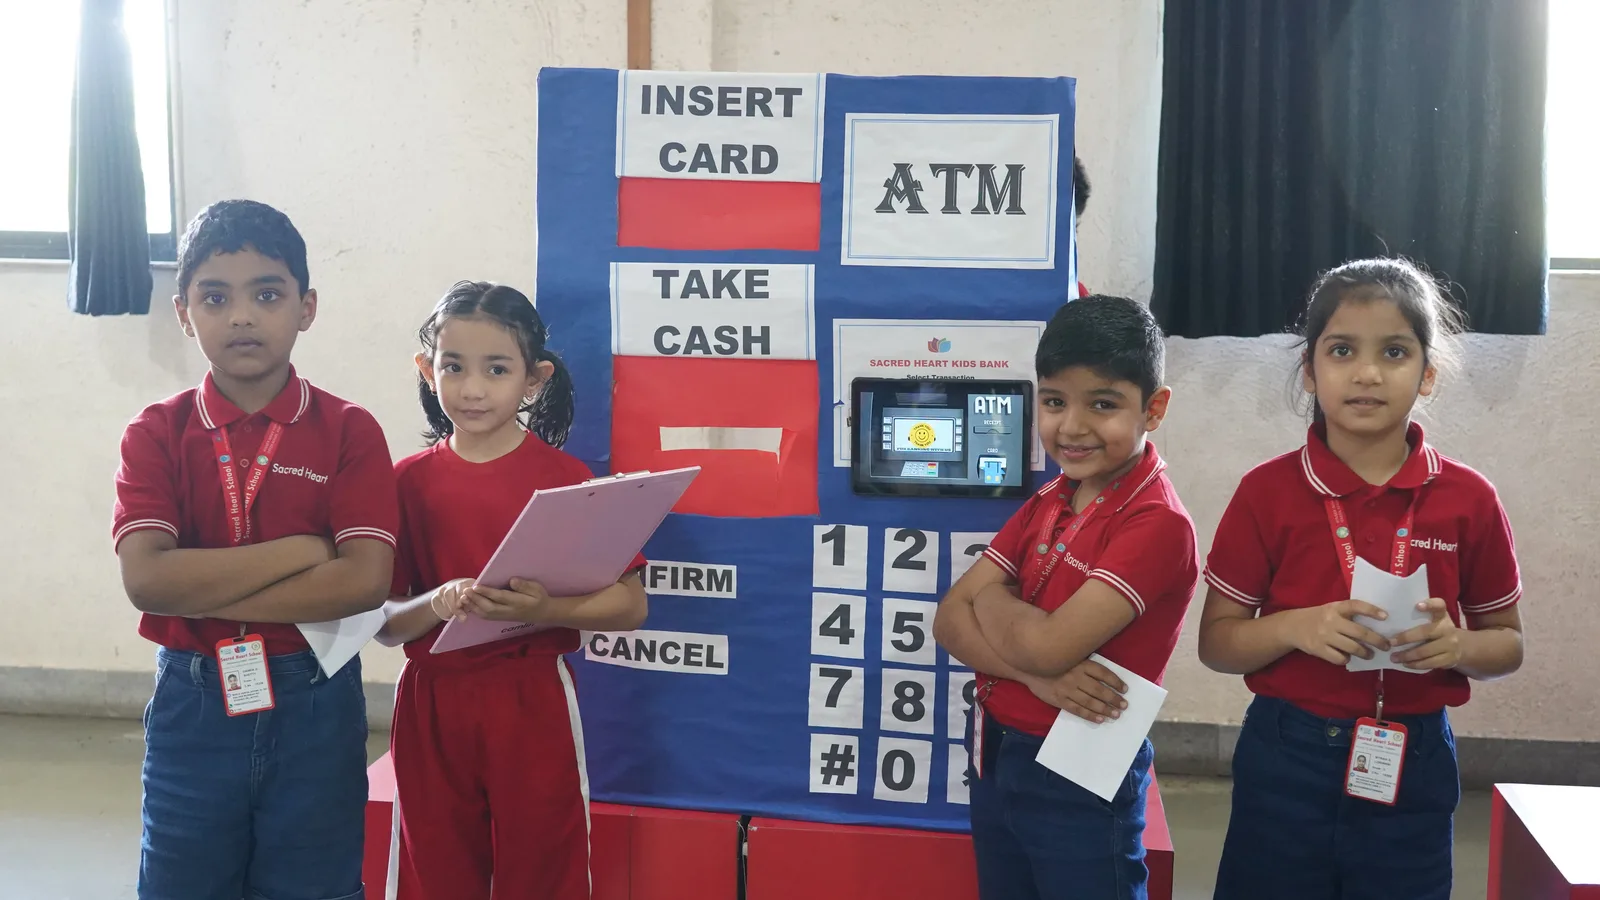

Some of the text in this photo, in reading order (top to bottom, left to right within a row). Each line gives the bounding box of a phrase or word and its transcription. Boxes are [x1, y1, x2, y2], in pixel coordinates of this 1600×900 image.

[641, 84, 803, 118] INSERT
[659, 142, 779, 175] CARD
[874, 162, 1026, 215] ATM
[652, 269, 770, 299] TAKE
[653, 325, 771, 356] CASH
[870, 359, 1009, 368] SACRED HEART KIDS BANK
[974, 396, 1012, 414] ATM
[247, 468, 262, 491] School
[272, 463, 329, 484] Sacred Heart
[223, 466, 242, 542] Sacred Heart School
[821, 525, 846, 566] 1
[891, 528, 928, 571] 2
[1341, 542, 1355, 569] School
[1394, 541, 1406, 568] School
[1410, 537, 1458, 552] cred Heart
[641, 565, 733, 593] FIRM
[1041, 553, 1060, 577] School
[1064, 551, 1090, 574] Sacred
[818, 603, 855, 645] 4
[890, 611, 925, 653] 5
[589, 633, 725, 669] CANCEL
[818, 667, 853, 708] 7
[891, 680, 926, 722] 8
[820, 743, 856, 786] #
[881, 749, 916, 792] 0
